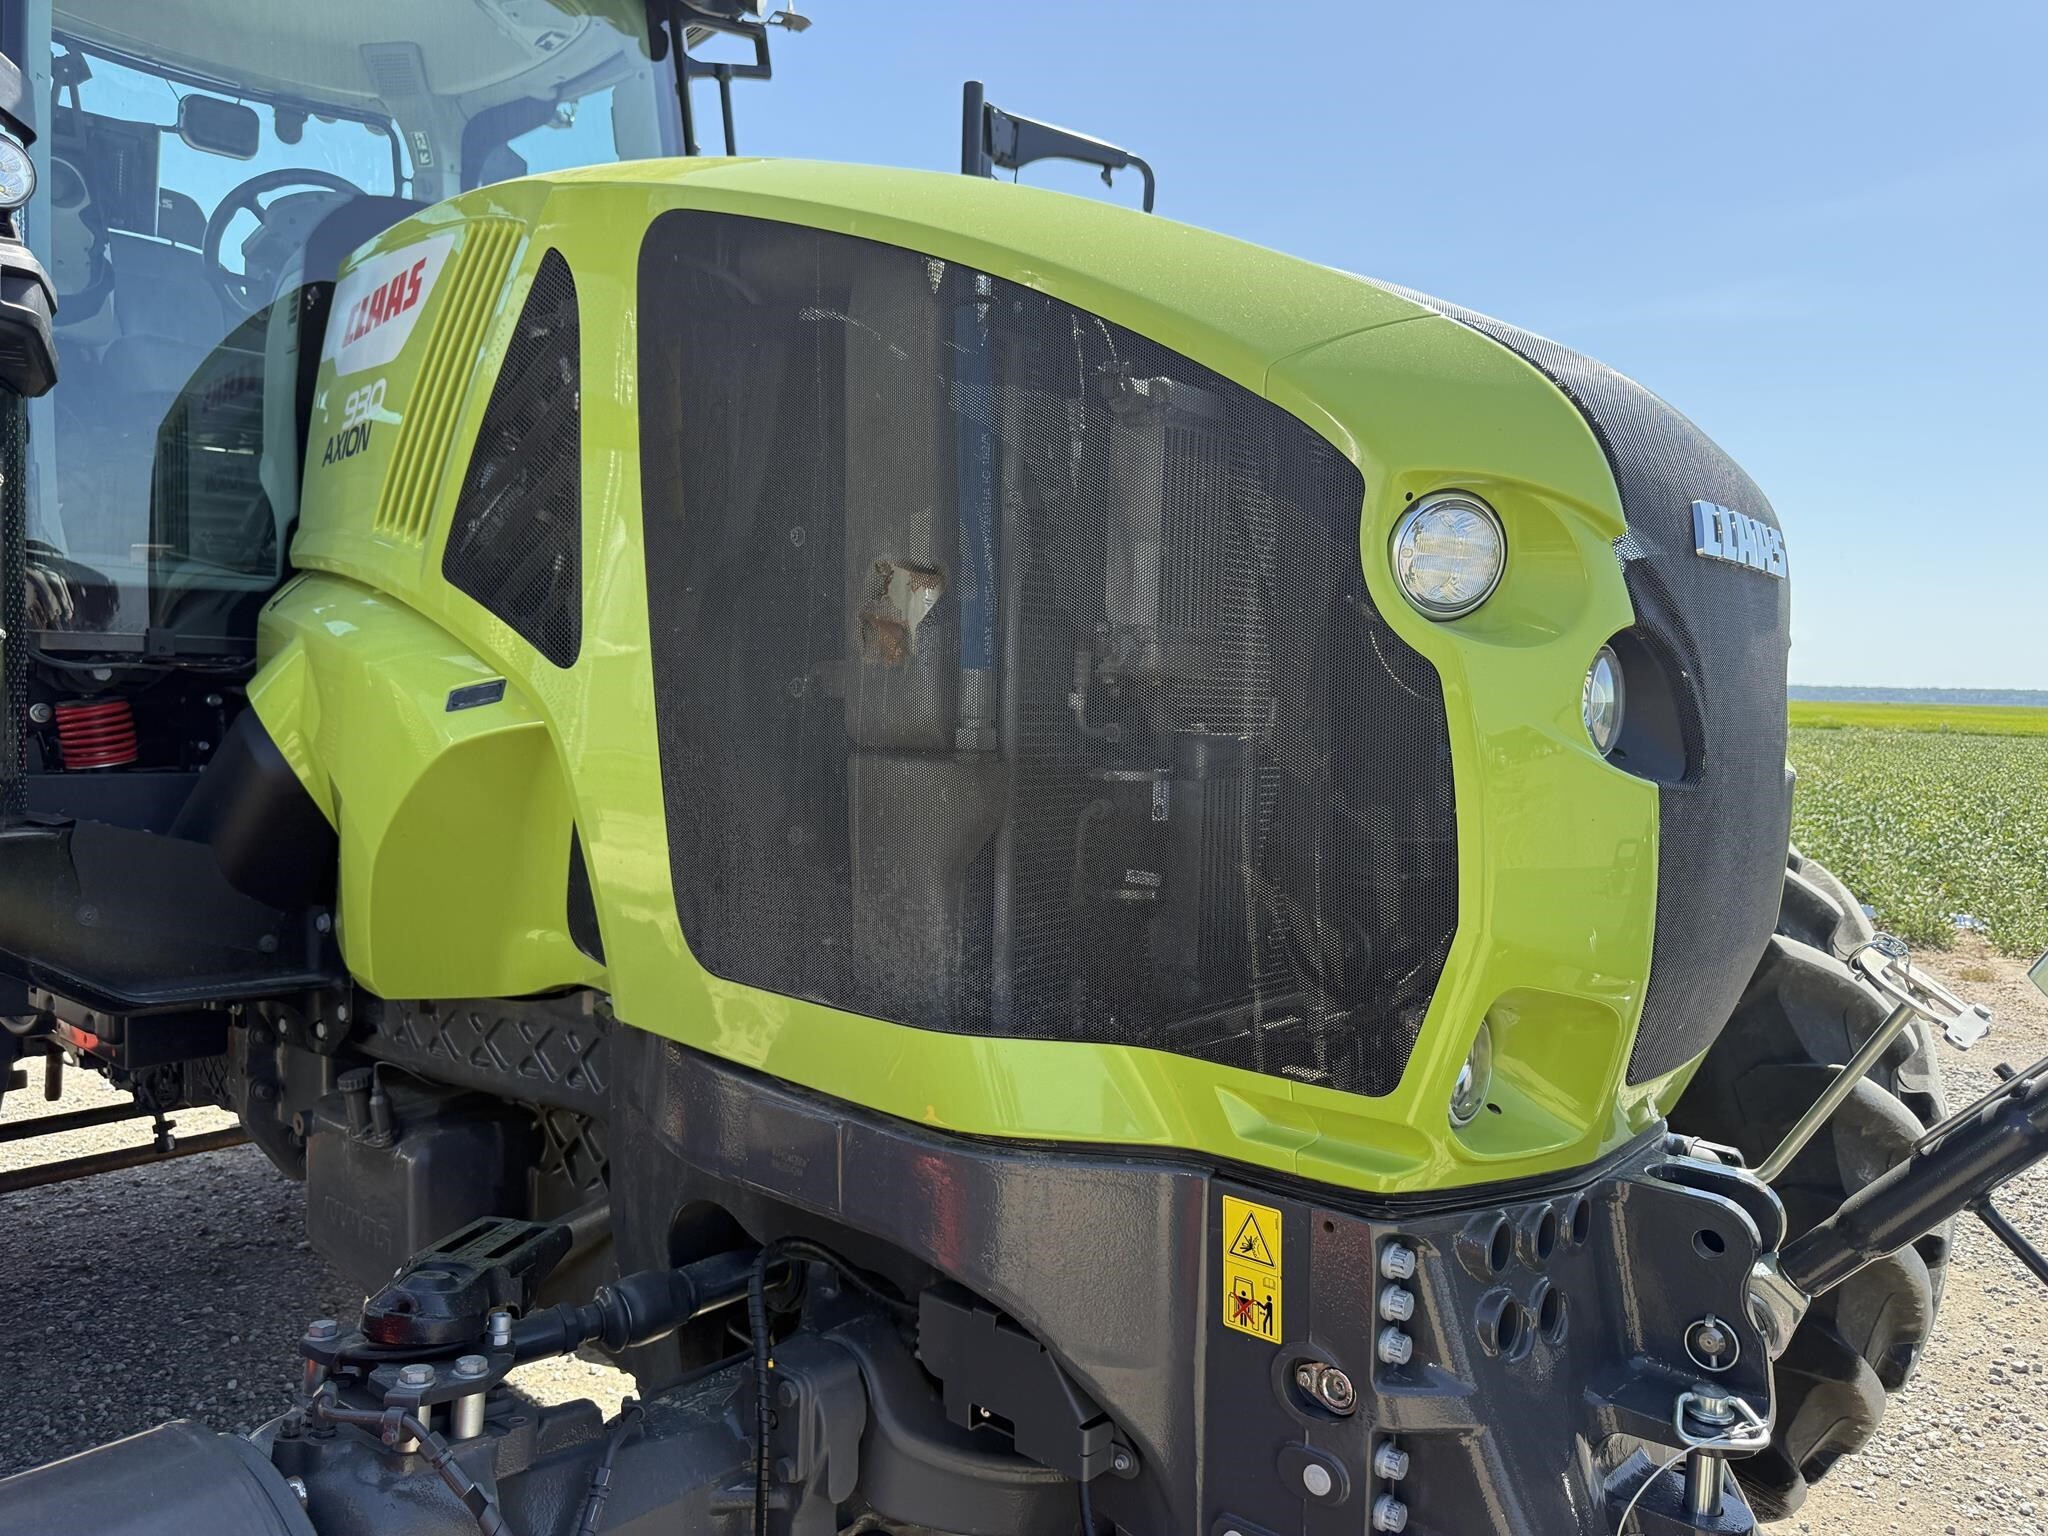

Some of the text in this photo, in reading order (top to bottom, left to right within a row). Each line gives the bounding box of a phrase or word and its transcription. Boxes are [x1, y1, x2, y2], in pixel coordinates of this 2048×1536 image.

[342, 257, 427, 349] CLAAS
[342, 377, 387, 431] 930
[321, 420, 373, 467] AXION
[1691, 500, 1786, 578] CLAAS
